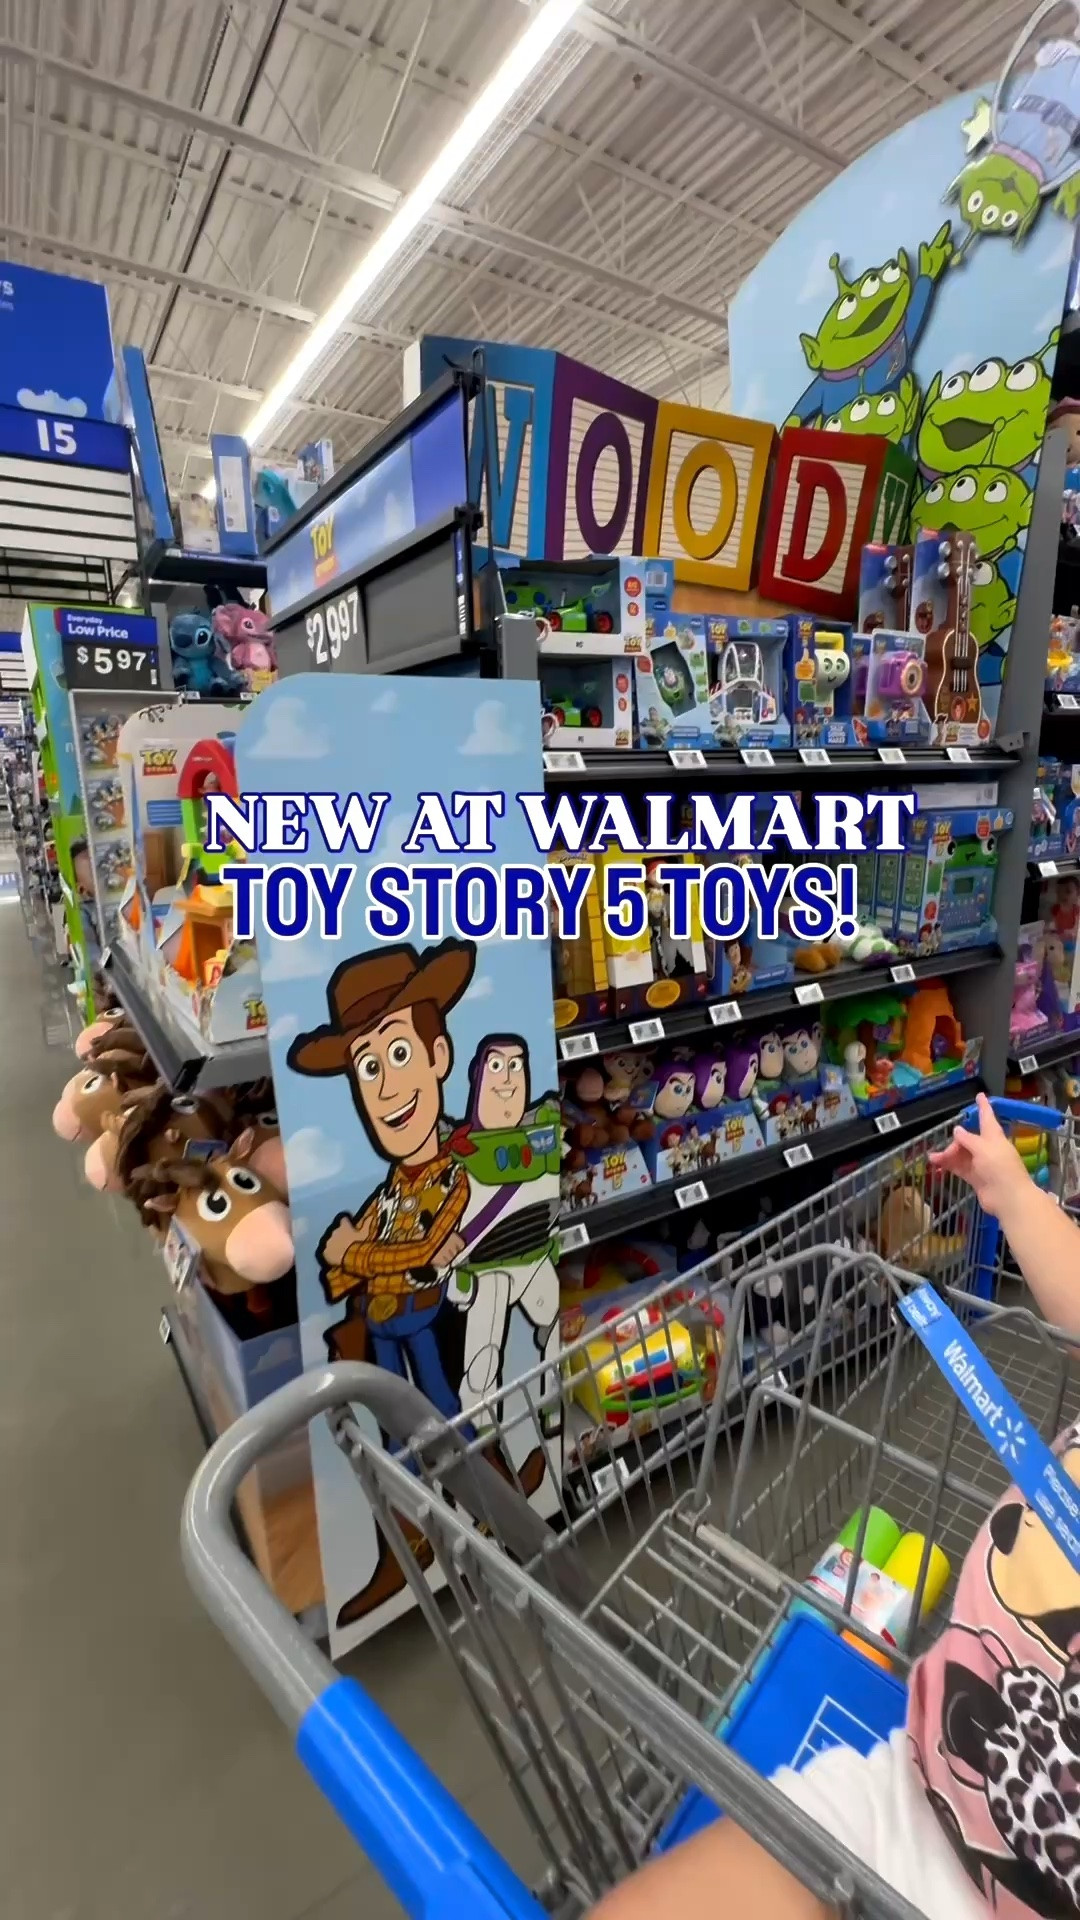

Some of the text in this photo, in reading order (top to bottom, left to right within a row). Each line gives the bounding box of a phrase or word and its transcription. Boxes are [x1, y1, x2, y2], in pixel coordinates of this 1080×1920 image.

[37, 419, 76, 455] 15
[67, 614, 103, 625] Everyday
[68, 623, 128, 639] Low Price
[140, 749, 178, 766] TOY
[603, 1151, 627, 1169] TOY
[944, 1339, 1004, 1429] Walmart
